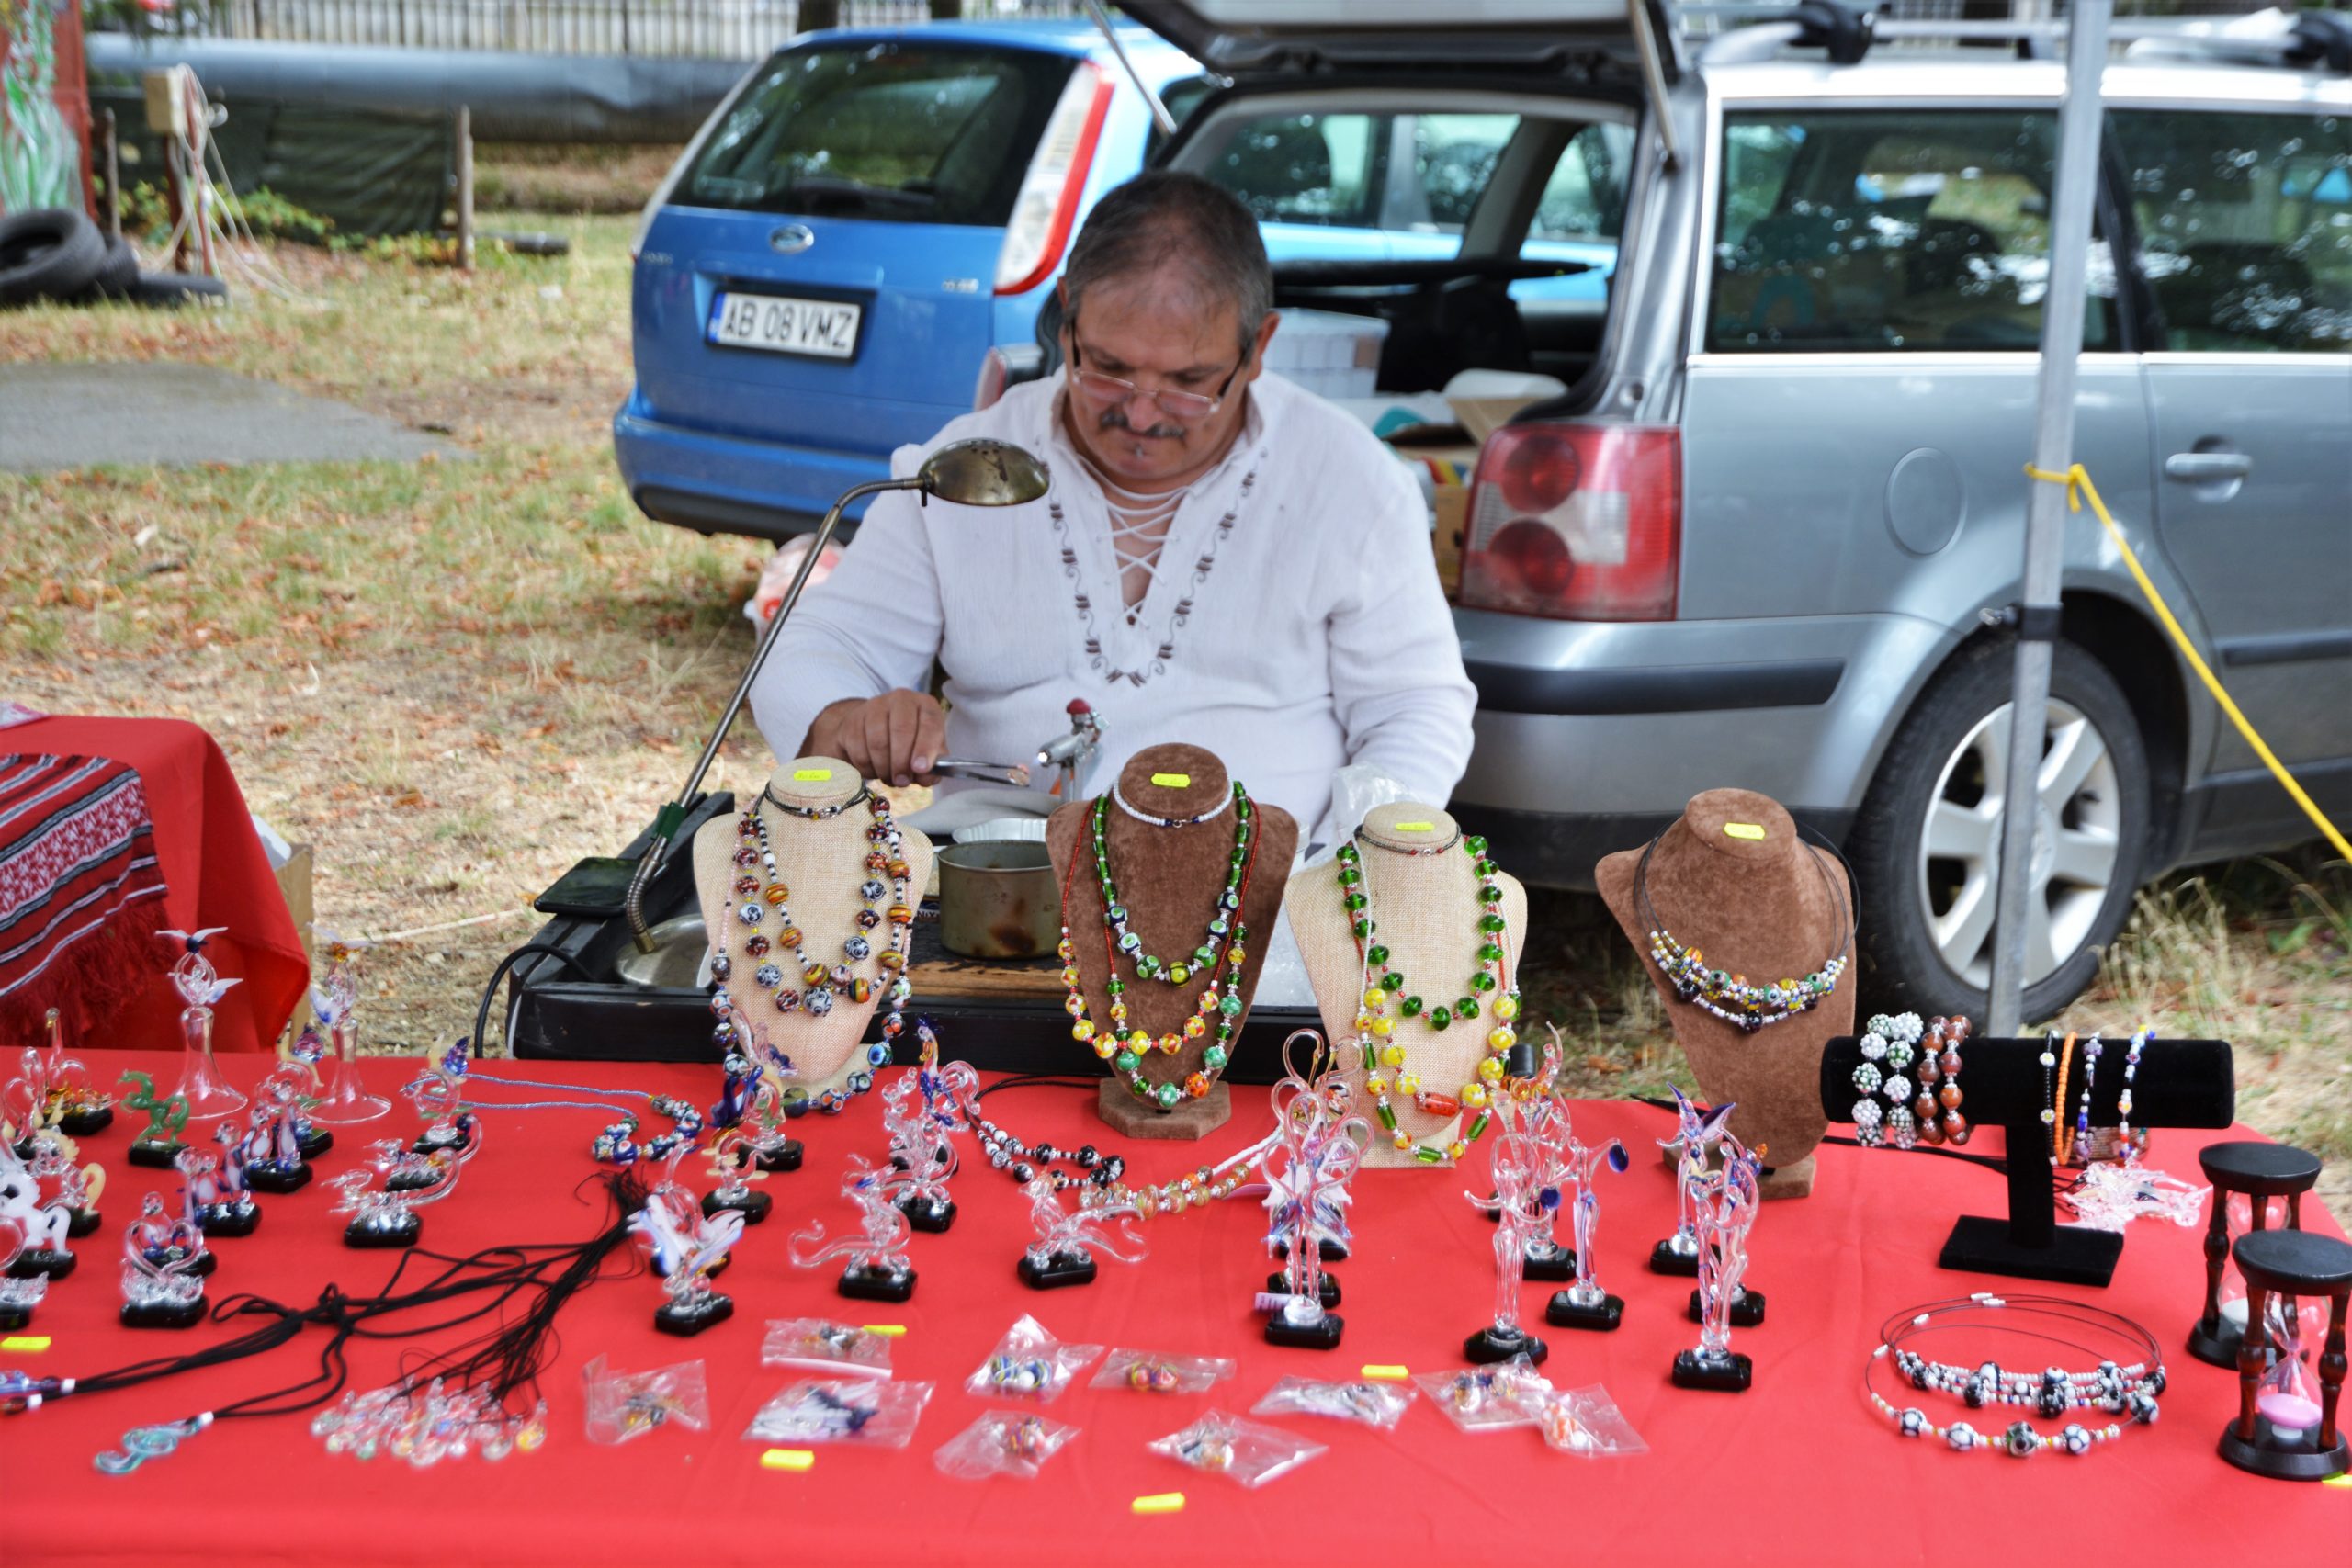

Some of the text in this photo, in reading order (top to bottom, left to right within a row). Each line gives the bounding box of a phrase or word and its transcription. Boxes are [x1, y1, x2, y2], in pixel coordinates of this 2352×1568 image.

[724, 301, 852, 348] AB 08 VMZ
